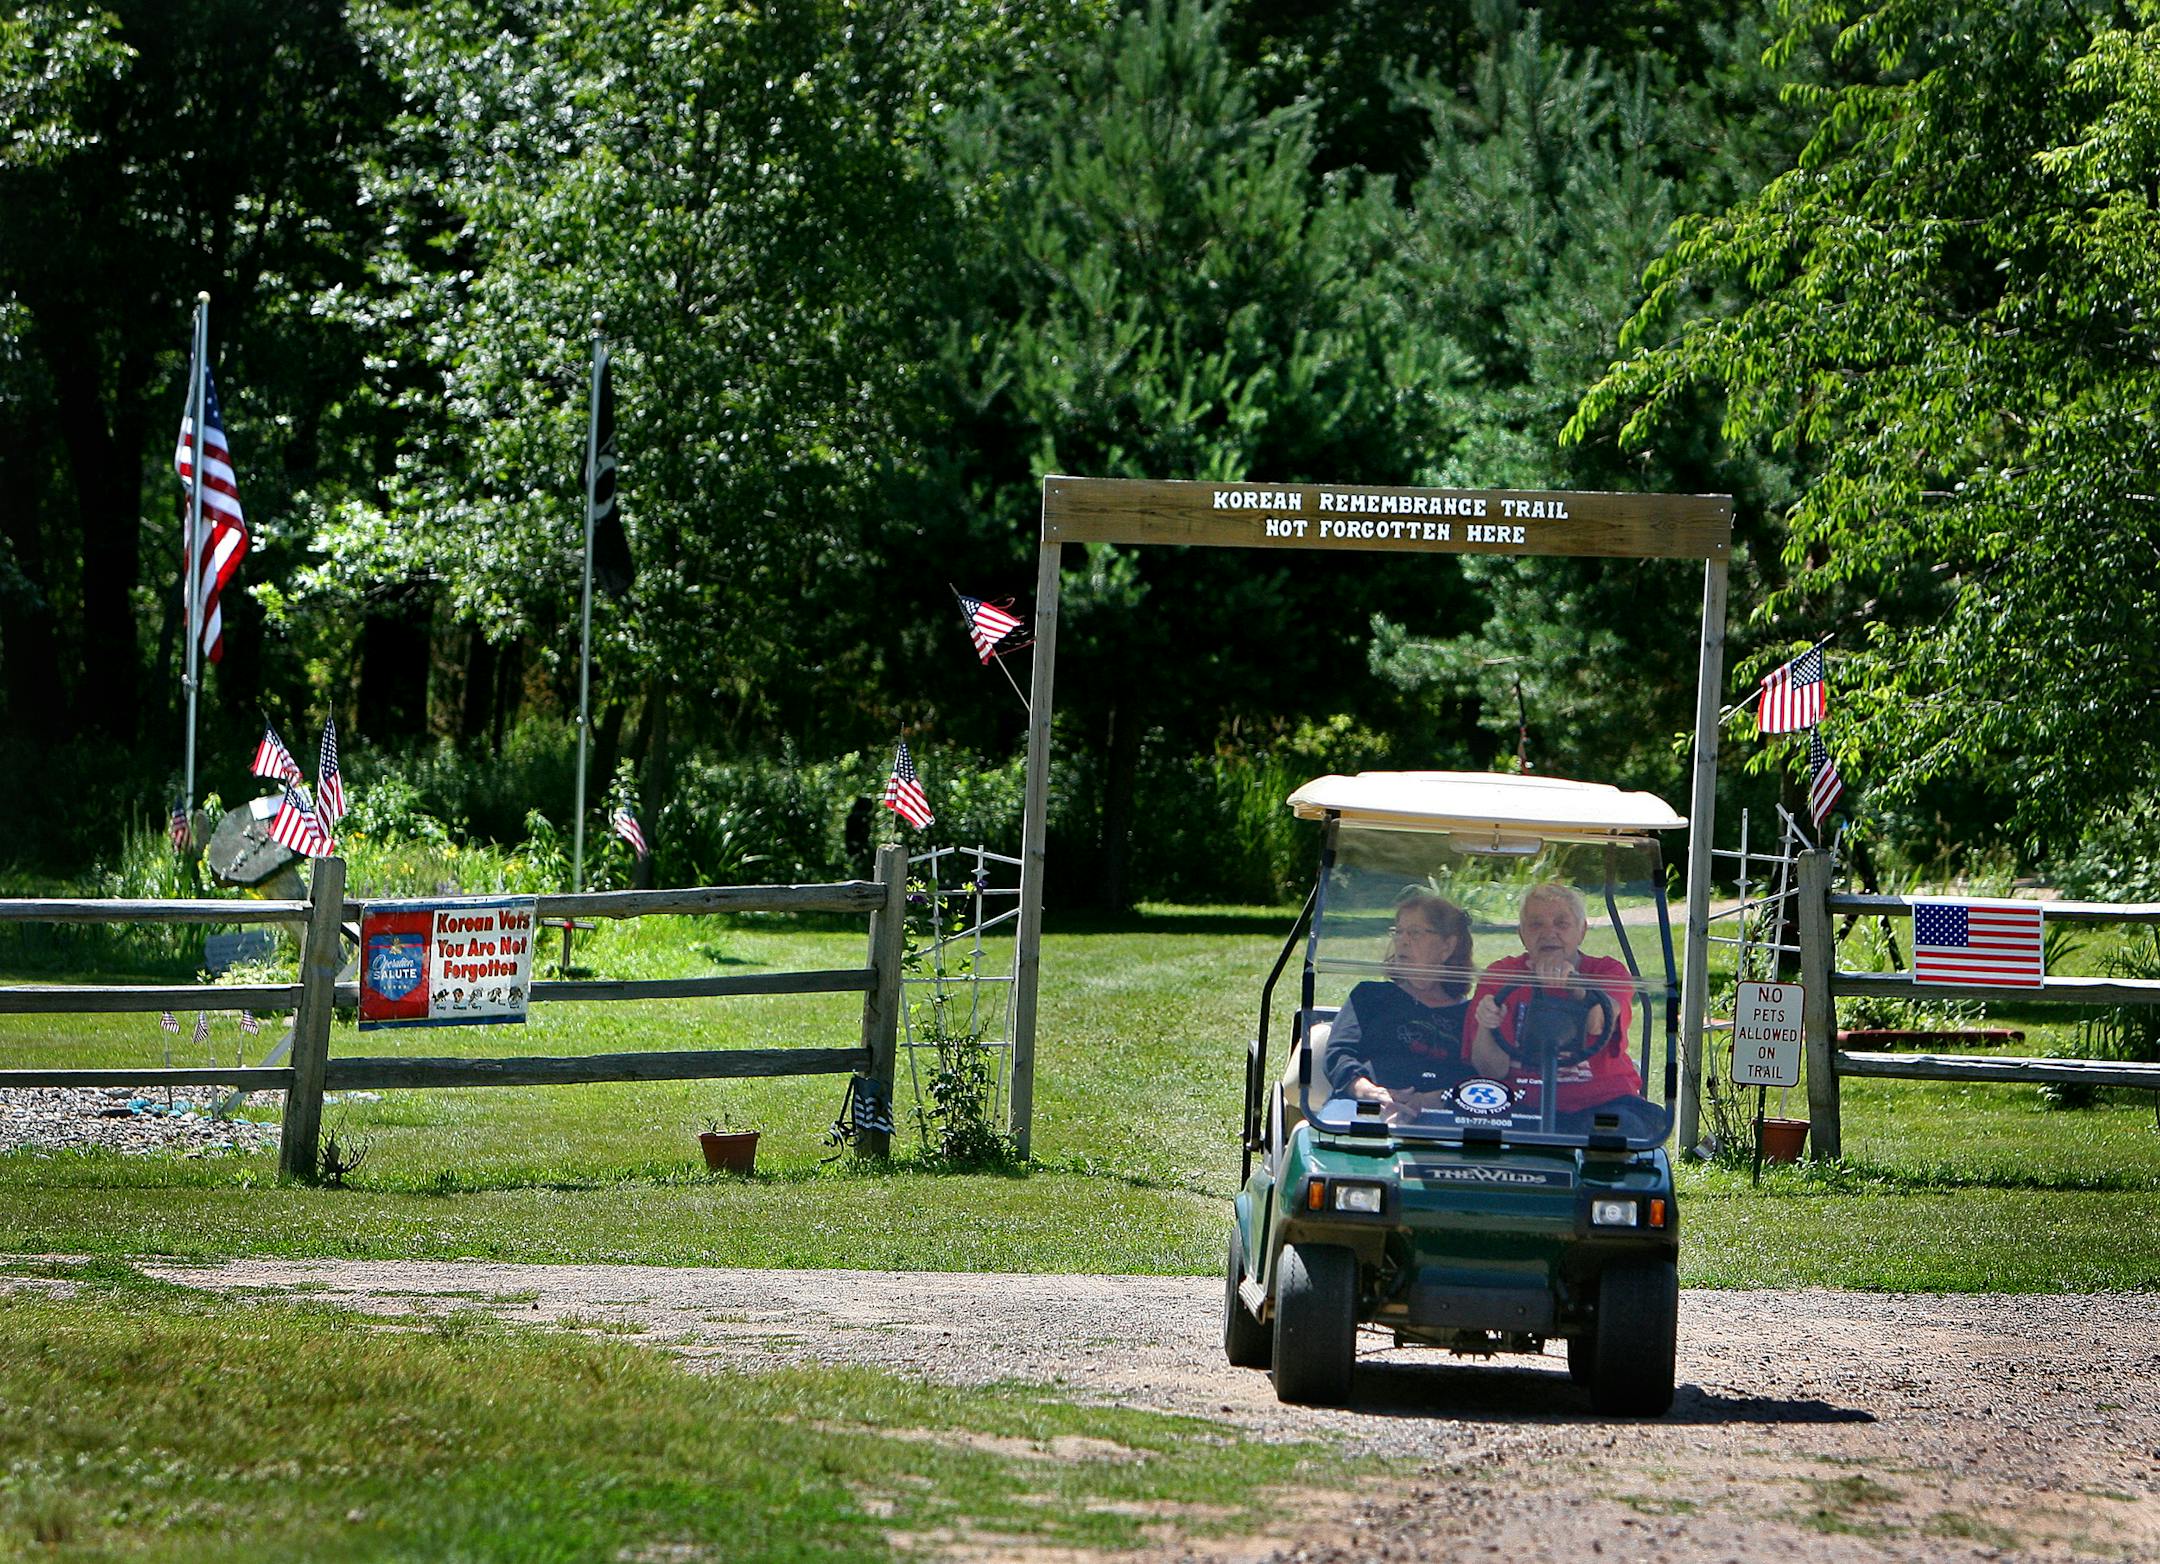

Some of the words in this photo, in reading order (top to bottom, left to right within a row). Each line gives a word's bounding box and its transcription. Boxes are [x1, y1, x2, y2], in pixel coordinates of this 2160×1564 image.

[1213, 491, 1301, 510] KOREAN
[1319, 493, 1486, 516] REMEMBRANCE
[1501, 499, 1568, 519] TRAIL
[1265, 519, 1308, 537] NOT
[1319, 520, 1450, 541] FORGOTTEN
[1467, 524, 1525, 544] HERE
[436, 913, 493, 933] Korean
[498, 910, 530, 930] Vets
[437, 939, 464, 957] You
[467, 938, 495, 956] Are
[500, 936, 527, 955] Not
[373, 968, 417, 980] SALUTE
[443, 960, 517, 982] Forgotten
[1758, 986, 1783, 1003] NO
[1753, 1008, 1785, 1022] PETS
[1739, 1027, 1797, 1042] ALLOWED
[1758, 1046, 1775, 1059] ON
[1747, 1064, 1783, 1079] TRAIL
